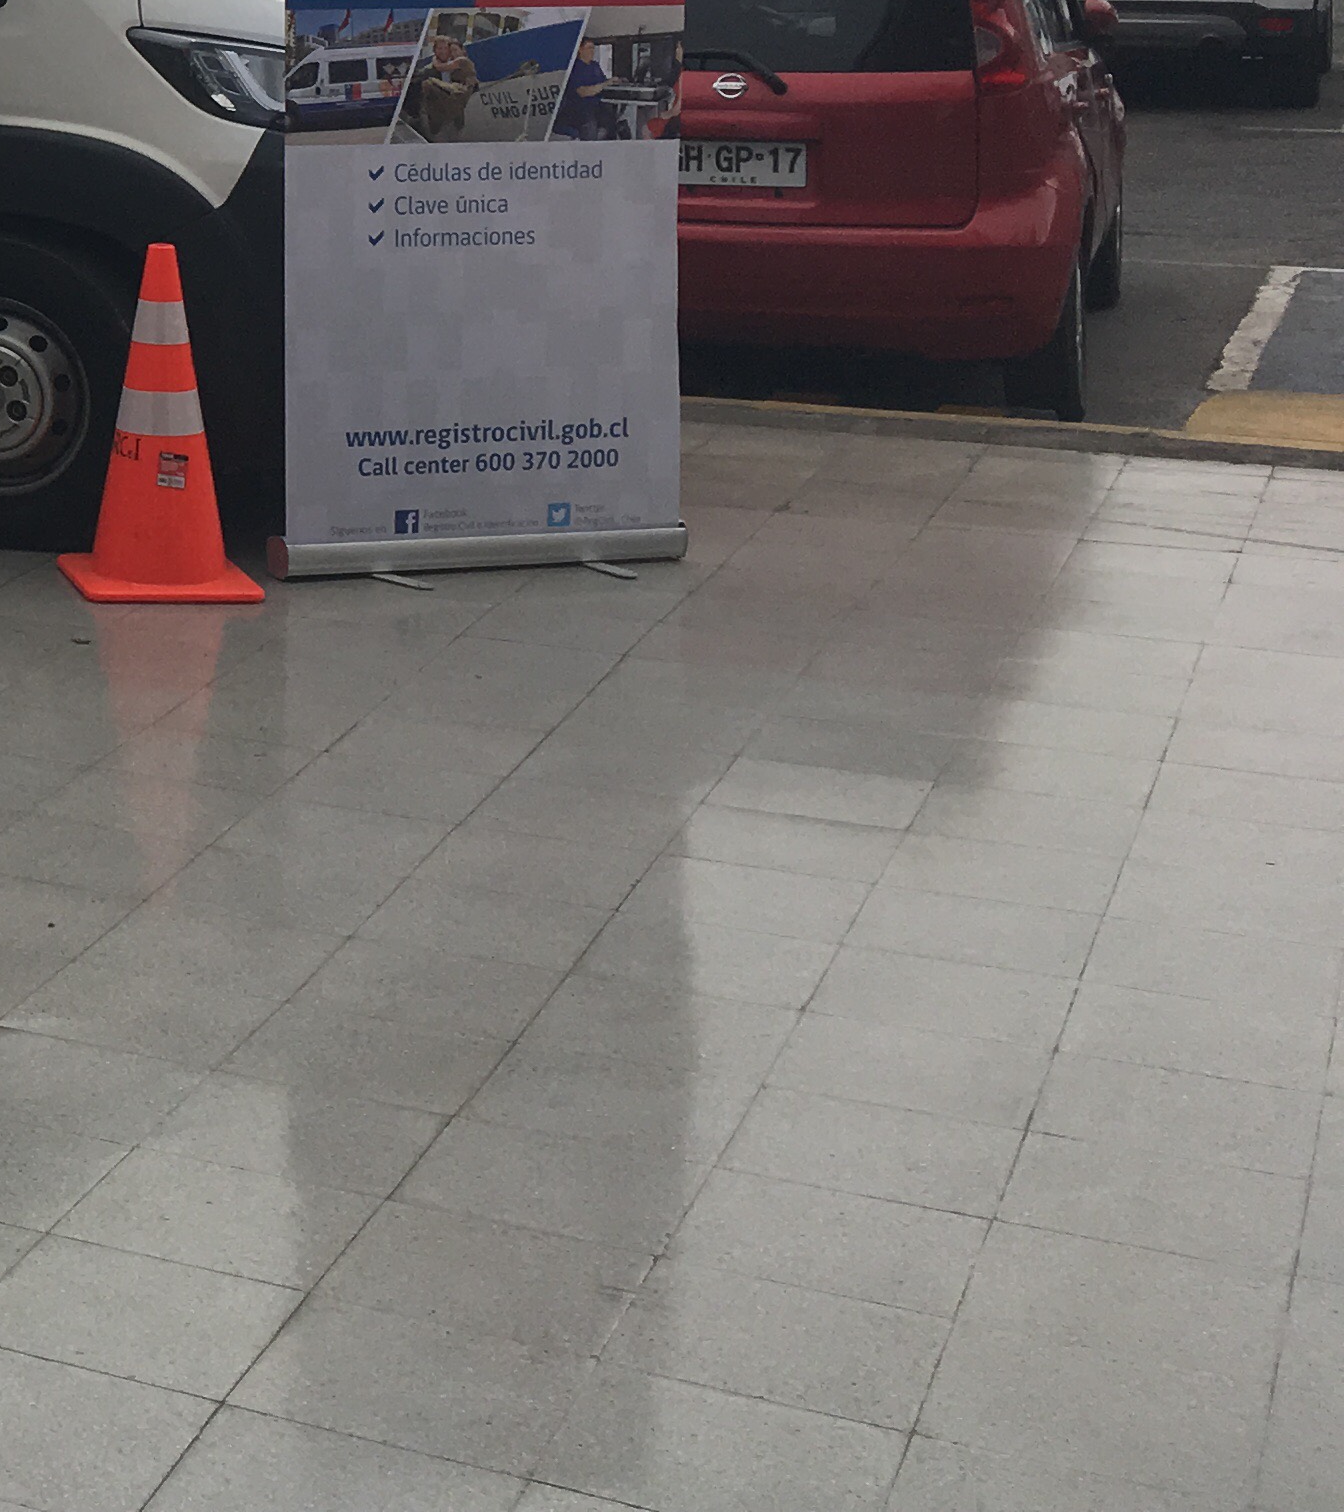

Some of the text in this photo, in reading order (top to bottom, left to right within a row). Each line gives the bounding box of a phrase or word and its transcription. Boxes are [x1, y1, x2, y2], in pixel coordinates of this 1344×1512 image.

[479, 91, 518, 106] CIVIL
[394, 160, 603, 182] Cédulas de identidad
[394, 194, 508, 216] Clave única
[394, 227, 536, 247] Informaciones
[345, 417, 630, 450] www.registrocivil.gob.cl
[358, 448, 620, 477] Call center 600 370 2000
